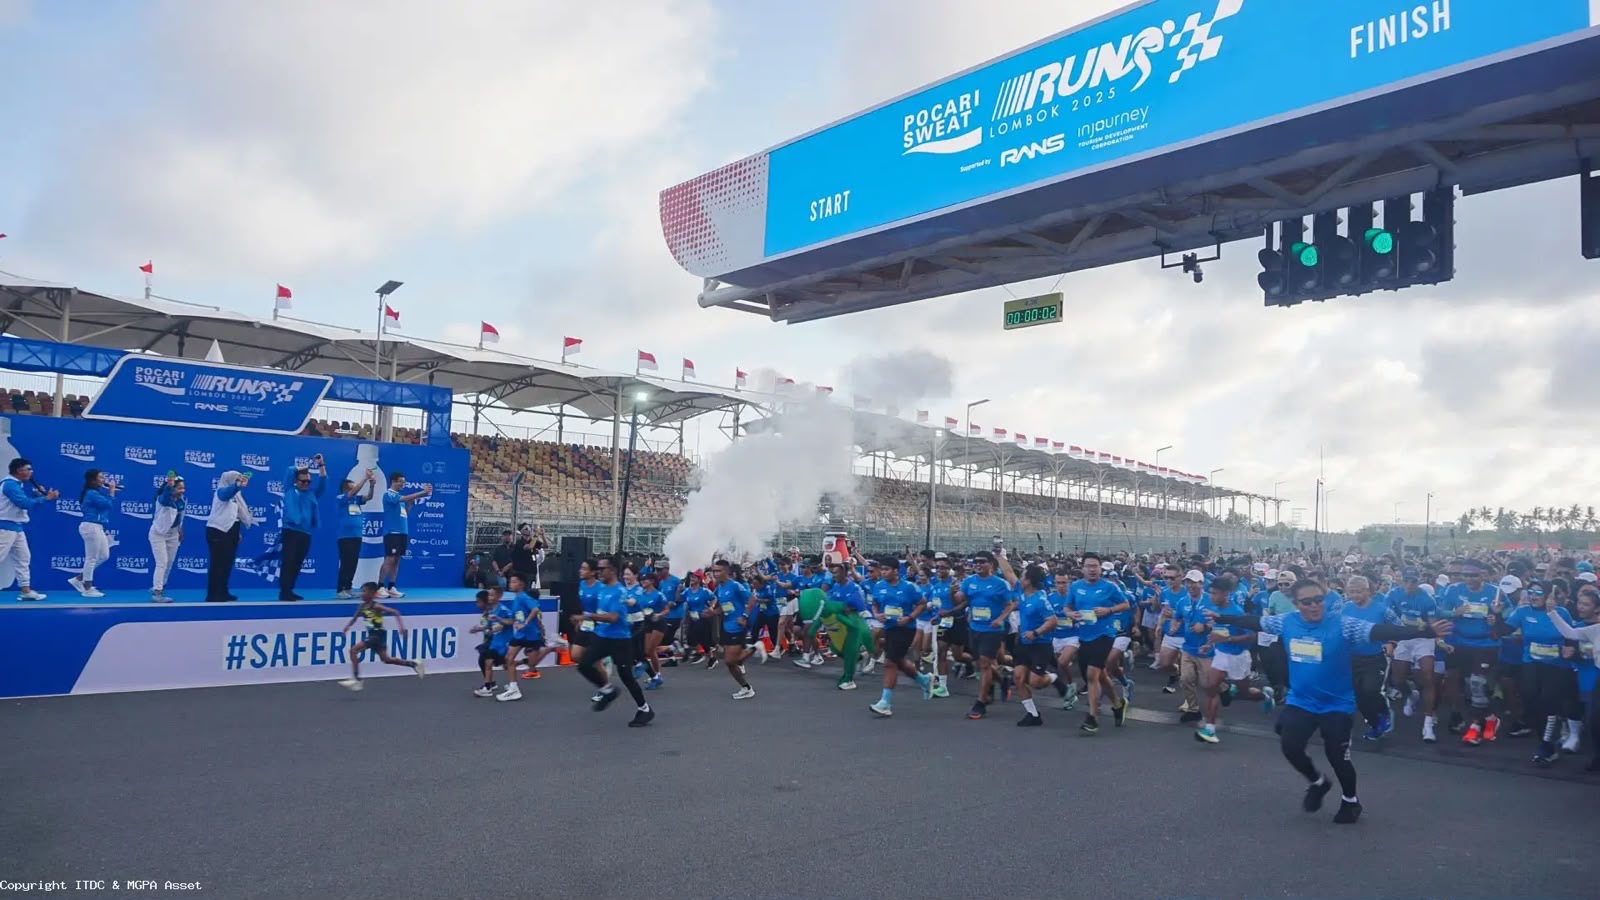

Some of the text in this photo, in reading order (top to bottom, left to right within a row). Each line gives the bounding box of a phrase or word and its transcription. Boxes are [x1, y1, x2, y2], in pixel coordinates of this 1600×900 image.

[1350, 0, 1450, 58] FINISH
[904, 89, 979, 132] POCARI
[990, 87, 1116, 138] LOMBOK 2025
[1077, 105, 1149, 138] injourney
[904, 110, 972, 148] SWEAT
[1078, 122, 1149, 148] TOURISM DEVELOPMENT
[1091, 134, 1134, 150] CORPORATION
[1000, 134, 1065, 168] RANS
[960, 160, 984, 172] Supported
[810, 190, 850, 222] START
[1007, 306, 1056, 324] 00:00:02
[135, 374, 180, 386] SWEAT
[136, 366, 184, 379] POCARI
[194, 402, 228, 412] RANS
[60, 443, 94, 451] POCARI
